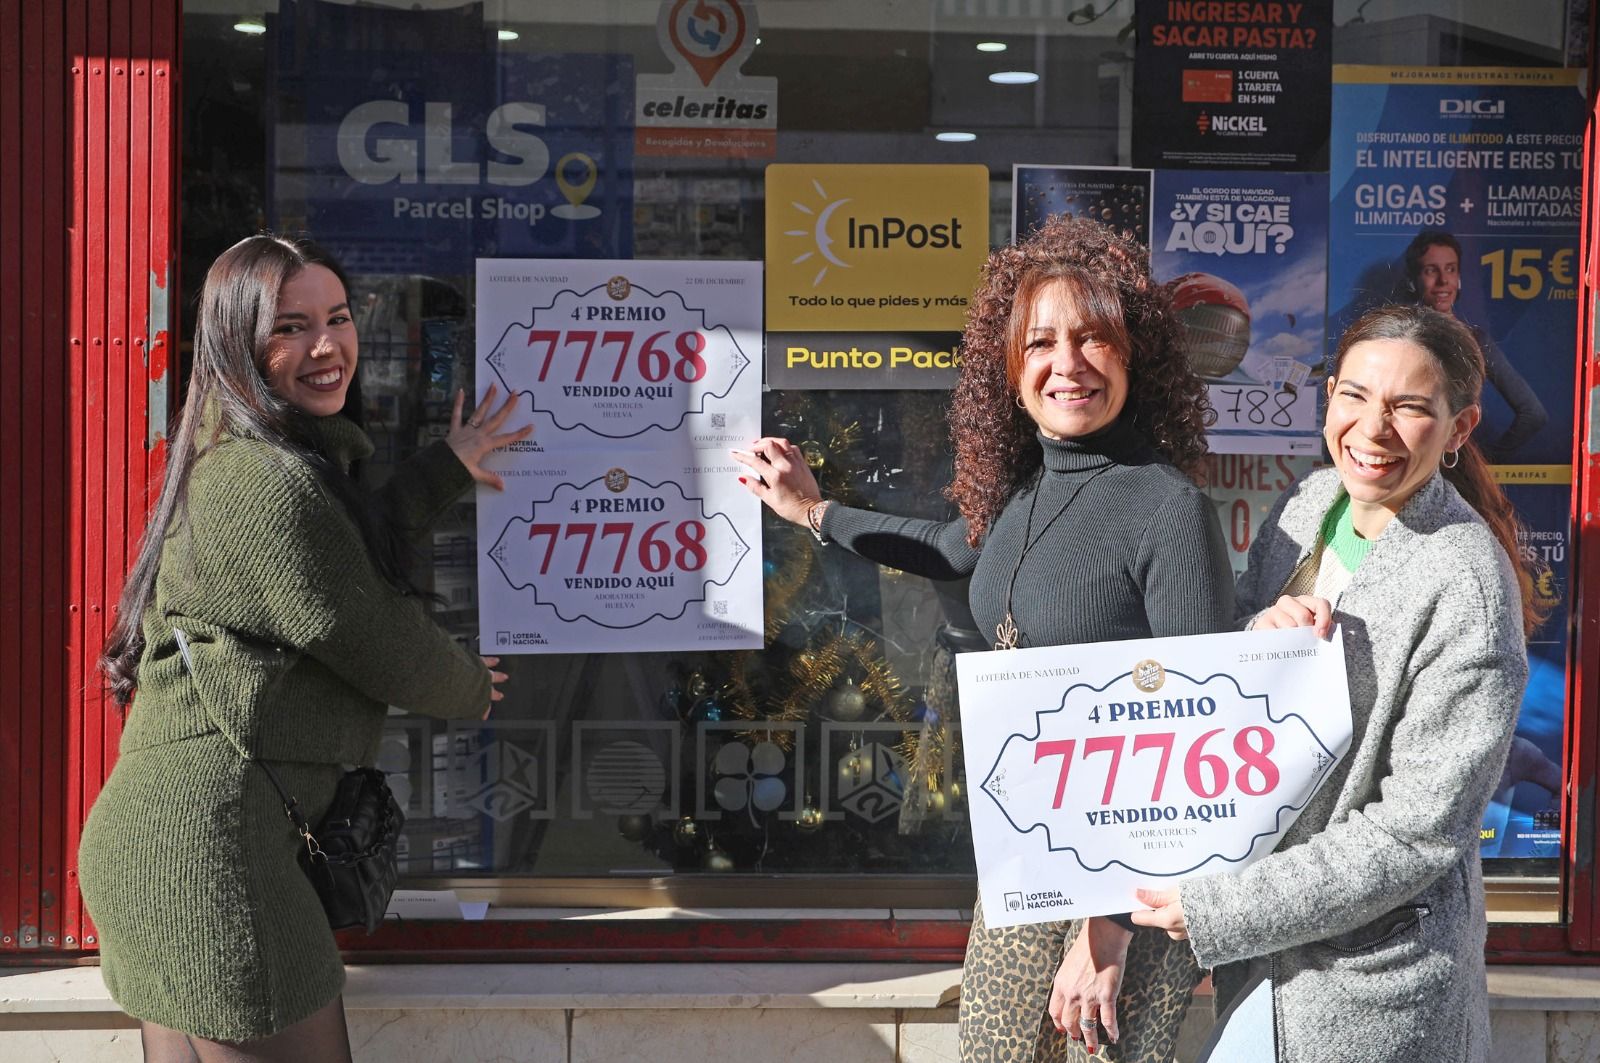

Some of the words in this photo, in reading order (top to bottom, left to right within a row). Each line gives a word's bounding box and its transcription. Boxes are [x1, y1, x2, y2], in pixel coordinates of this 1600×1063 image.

[1168, 0, 1282, 22] INGRESAR
[1287, 1, 1302, 23] Y
[1153, 25, 1228, 46] SACAR
[1234, 26, 1316, 48] PASTA?
[1238, 71, 1243, 79] 1
[1244, 71, 1279, 80] CUENTA
[1391, 71, 1451, 79] MEJORAMOS
[1457, 72, 1509, 80] NUESTRAS
[1514, 72, 1554, 80] TARIFAS
[1238, 83, 1243, 91] 1
[1244, 83, 1282, 92] TARJETA
[1238, 95, 1250, 103] EN
[1251, 95, 1257, 103] 5
[1258, 95, 1275, 104] MIN
[1440, 99, 1504, 114] DIGI
[643, 96, 768, 119] celeritas
[338, 100, 549, 186] GLS
[646, 137, 693, 148] Recogidas
[696, 139, 702, 148] y
[1356, 132, 1430, 144] DISFRUTANDO
[1433, 133, 1447, 144] DE
[1449, 133, 1503, 145] ILIMITODO
[1506, 134, 1514, 145] A
[1516, 135, 1543, 145] ESTE
[1356, 149, 1377, 168] EL
[1383, 149, 1504, 169] INTELIGENTE
[1509, 151, 1555, 169] ERES
[1560, 147, 1583, 169] TÚ
[1203, 187, 1230, 195] GORDO
[1210, 193, 1230, 201] ESTÁ
[1242, 195, 1290, 203] VACACIONES
[1355, 183, 1446, 209] GIGAS
[1488, 185, 1583, 201] LLAMADAS
[393, 198, 474, 219] Parcel
[481, 198, 546, 225] Shop
[1170, 202, 1202, 221] ¿Y
[1206, 203, 1231, 222] SI
[1236, 203, 1289, 222] CAE
[1355, 211, 1446, 226] ILIMITADOS
[1487, 202, 1583, 217] ILIMITADAS
[848, 217, 962, 249] InPost
[1165, 222, 1294, 256] AQUÍ?
[533, 274, 568, 283] NAVIDAD
[706, 278, 744, 286] DICIEMBRE
[789, 295, 827, 306] Todo
[831, 295, 844, 306] lo
[847, 298, 875, 308] que
[879, 295, 919, 308] pides
[923, 298, 931, 308] y
[935, 295, 968, 306] más
[587, 306, 666, 321] PREMIO
[527, 330, 707, 383] 77768
[787, 347, 882, 368] Punto
[563, 385, 630, 397] VENDIDO
[634, 382, 673, 400] AQUÍ
[602, 411, 632, 419] HUELVA
[533, 469, 567, 477] NAVIDAD
[692, 466, 702, 474] DE
[586, 497, 665, 513] PREMIO
[1530, 531, 1564, 542] PRECIO,
[528, 519, 707, 575] 77768
[1541, 542, 1564, 562] TÚ
[564, 576, 631, 589] VENDIDO
[636, 572, 674, 590] AQUÍ
[594, 592, 645, 600] ADORATRICES
[1239, 654, 1249, 662] 22
[1251, 653, 1265, 661] DE
[1266, 648, 1318, 660] DICIEMBRE
[976, 672, 1017, 683] LOTERÍA
[1019, 671, 1032, 680] DE
[1034, 666, 1080, 677] NAVIDAD
[1108, 696, 1216, 721] PREMIO
[1034, 725, 1280, 809] 77768
[1085, 806, 1178, 825] VENDIDO
[1184, 798, 1237, 823] AQUÍ
[1128, 827, 1197, 839] ADORATRICES
[1143, 840, 1184, 850] HUELVA
[1026, 890, 1063, 901] LOTERÍA
[1027, 898, 1074, 909] NACIONAL
